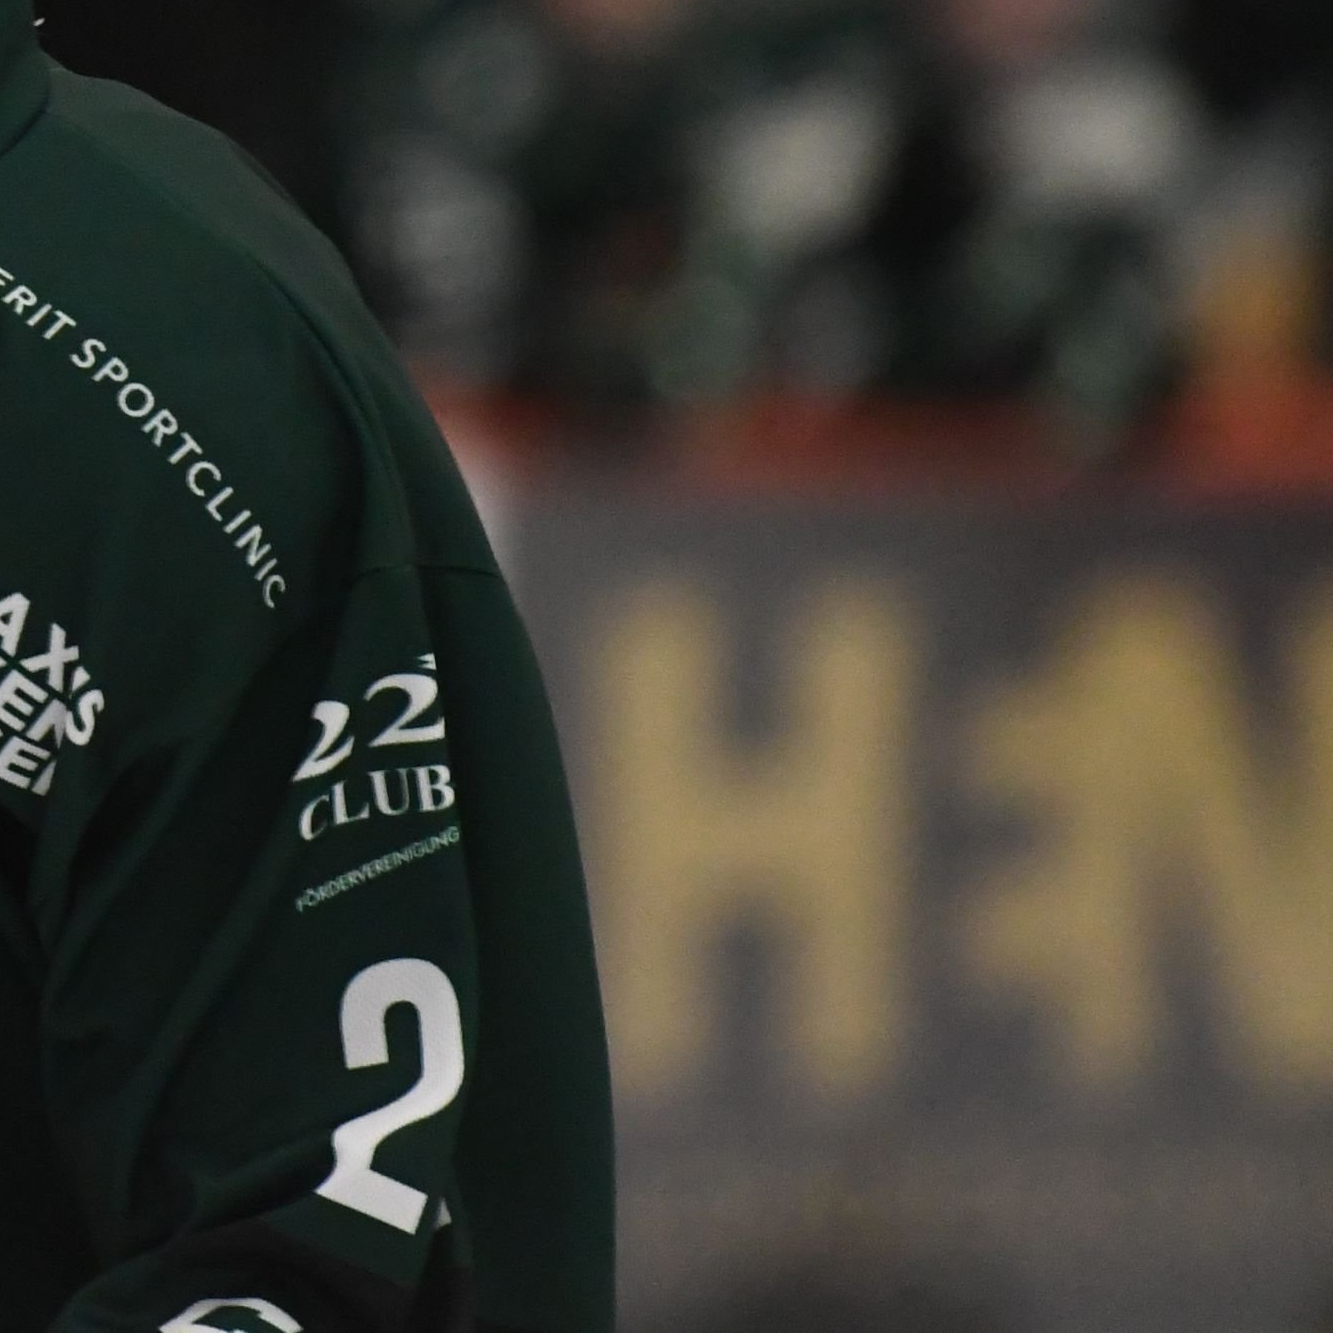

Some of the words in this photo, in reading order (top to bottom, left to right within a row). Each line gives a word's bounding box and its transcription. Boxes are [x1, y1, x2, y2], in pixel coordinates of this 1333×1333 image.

[69, 337, 288, 610] SPORTCLINIC
[291, 672, 446, 783] 22
[298, 764, 456, 842] CLUB
